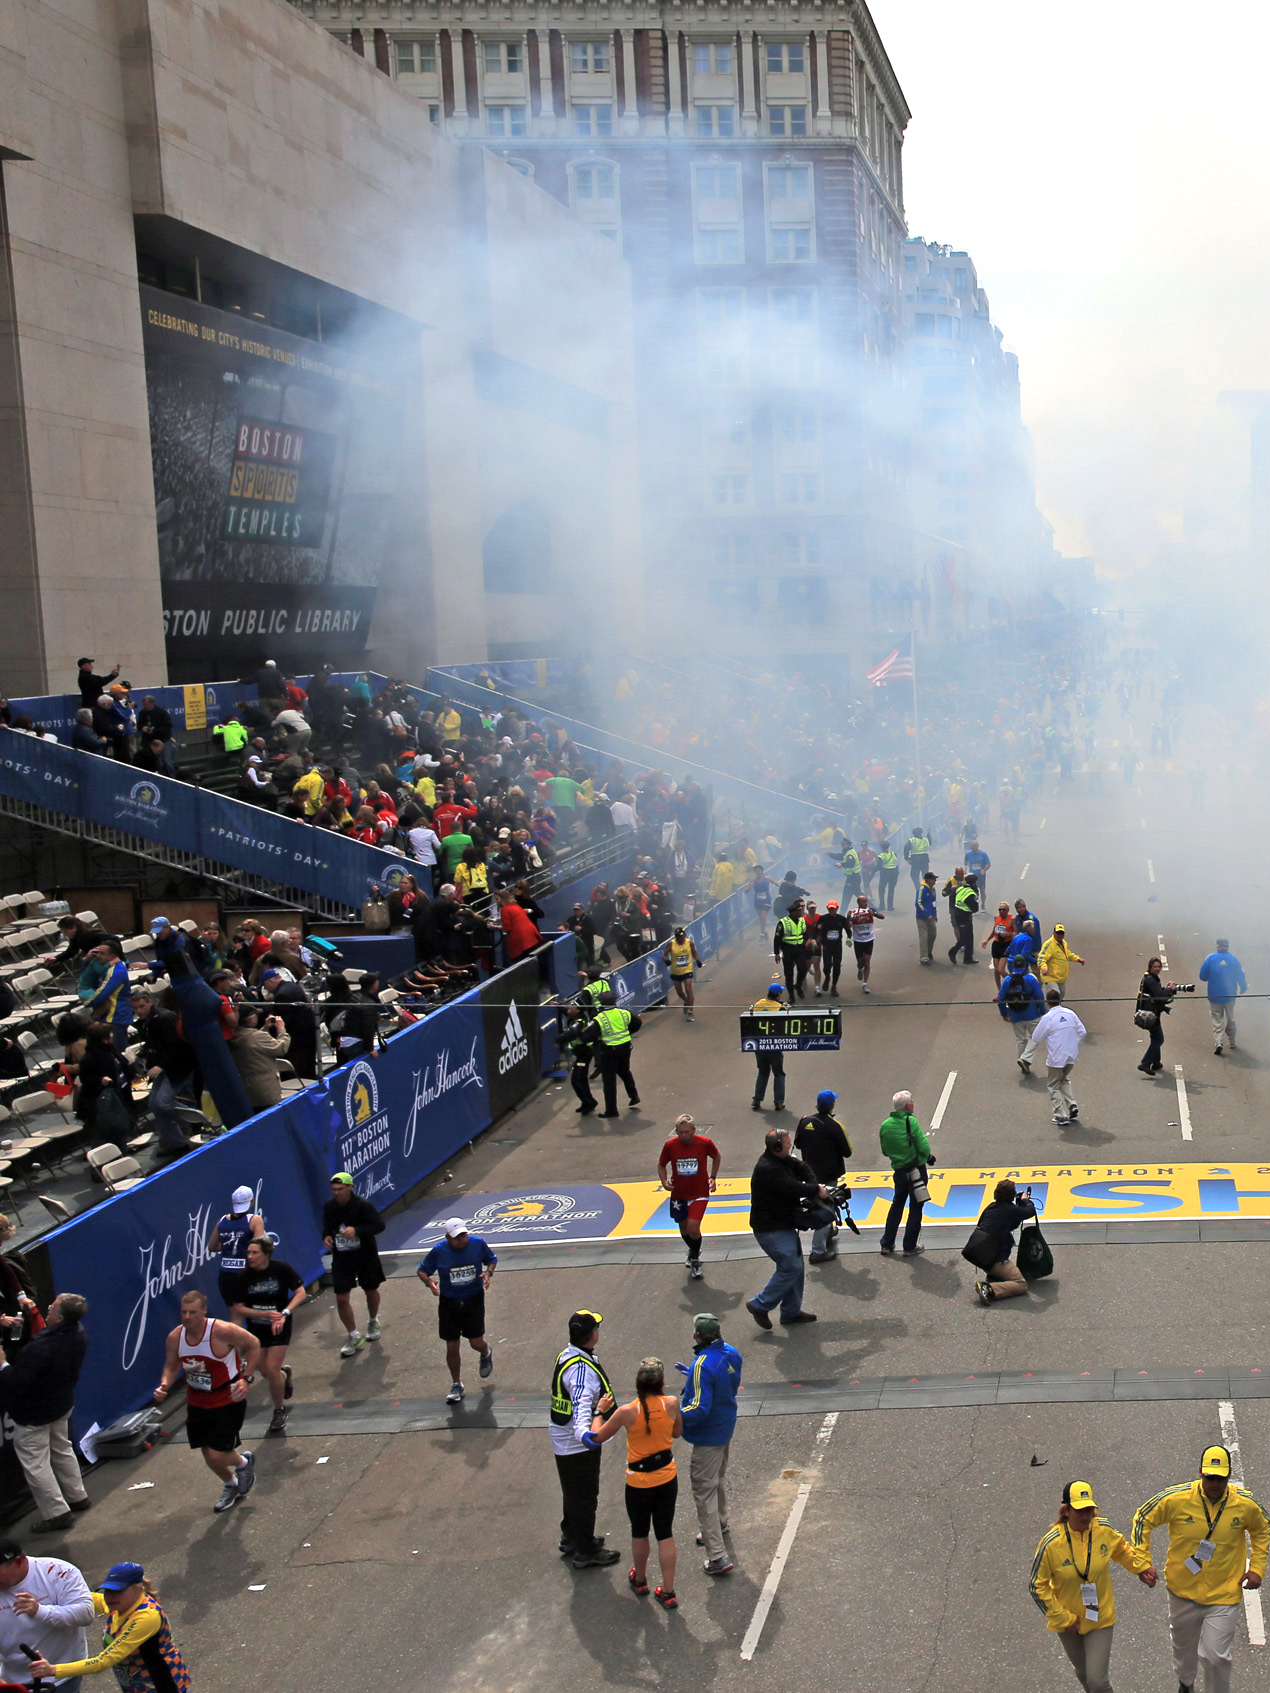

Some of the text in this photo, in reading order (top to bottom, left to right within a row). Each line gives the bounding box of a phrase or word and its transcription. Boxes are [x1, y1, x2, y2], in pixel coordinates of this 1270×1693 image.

[148, 309, 199, 337] CELEBRATING
[201, 326, 216, 342] OUR
[218, 331, 240, 350] CITY'S
[242, 339, 271, 359] HISTORIC
[272, 348, 296, 367] VENUES
[239, 424, 303, 461] BOSTON
[233, 463, 297, 499] SPORTS
[228, 505, 302, 538] TEMPLES
[221, 609, 288, 636] PUBLIC
[294, 609, 362, 634] LIBRARY
[44, 771, 72, 787] DAY
[218, 828, 322, 868] PATRIOTS' DAY
[758, 1018, 835, 1036] 4:10:10
[498, 1038, 528, 1075] adidas
[404, 1034, 484, 1158] John Hancock
[357, 1114, 389, 1148] BOSTON
[343, 1131, 391, 1175] MARATHON
[978, 1166, 1174, 1180] MARATHON
[501, 1210, 599, 1223] MARATHON
[122, 1234, 184, 1371] John
